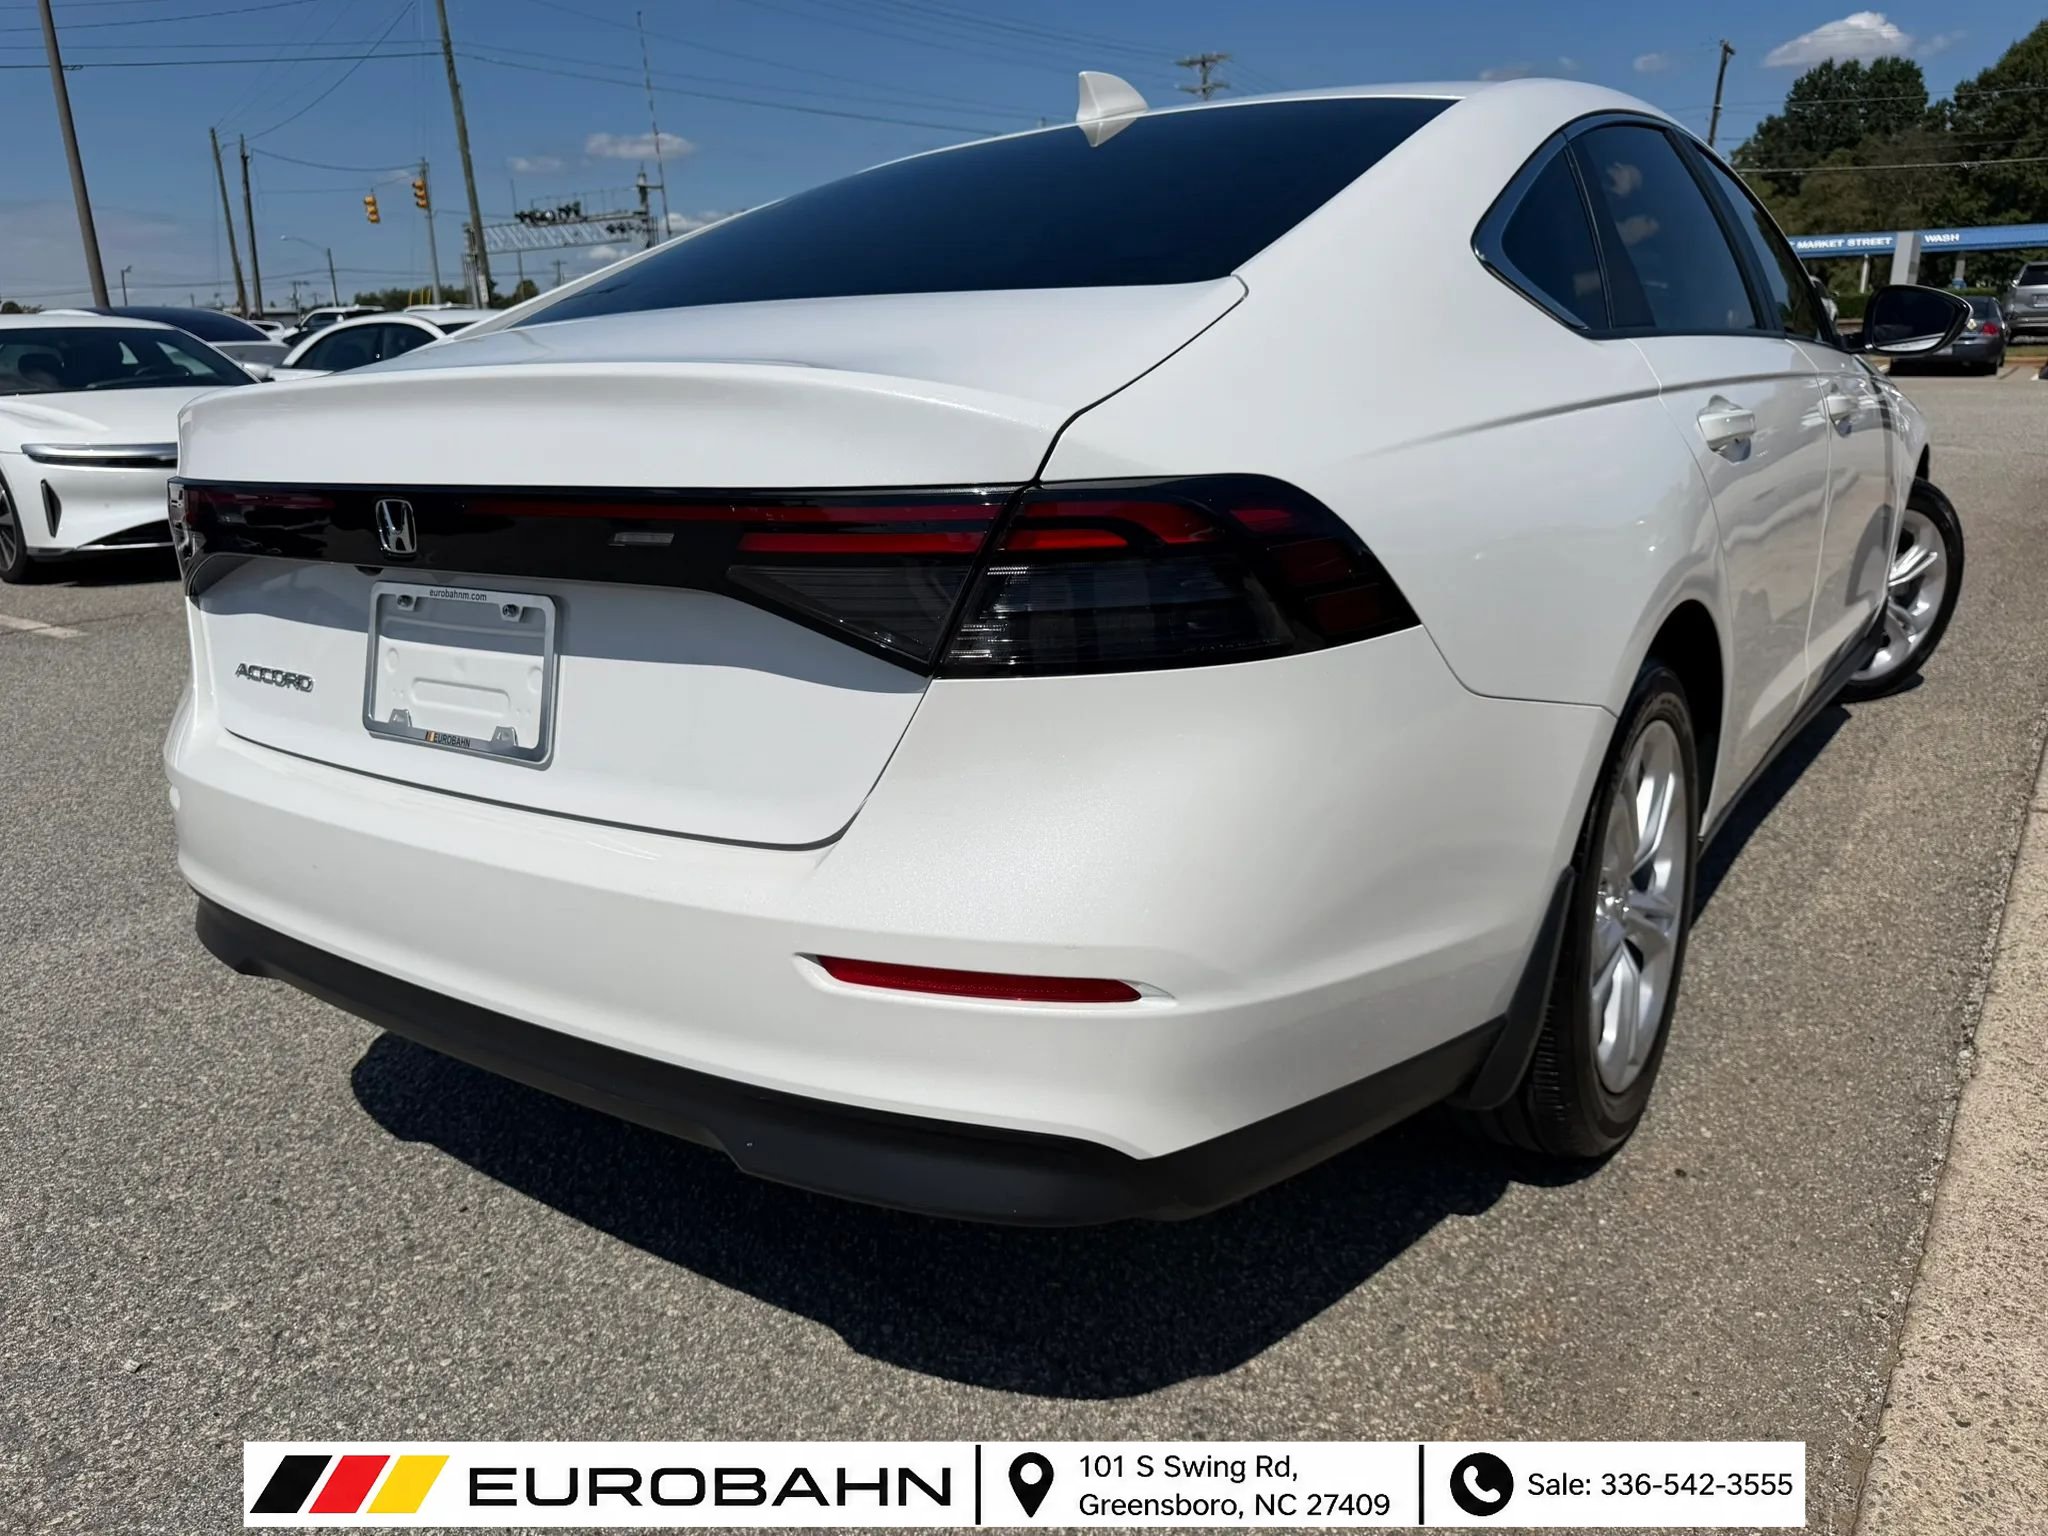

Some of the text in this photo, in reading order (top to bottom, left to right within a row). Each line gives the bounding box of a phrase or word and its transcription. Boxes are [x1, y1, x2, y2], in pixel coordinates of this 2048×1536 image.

[1797, 239, 1844, 249] MARKET
[1847, 237, 1892, 247] STREET
[1924, 233, 1960, 243] WASH
[235, 663, 314, 693] ACCORD
[433, 731, 471, 748] EUROBAHN
